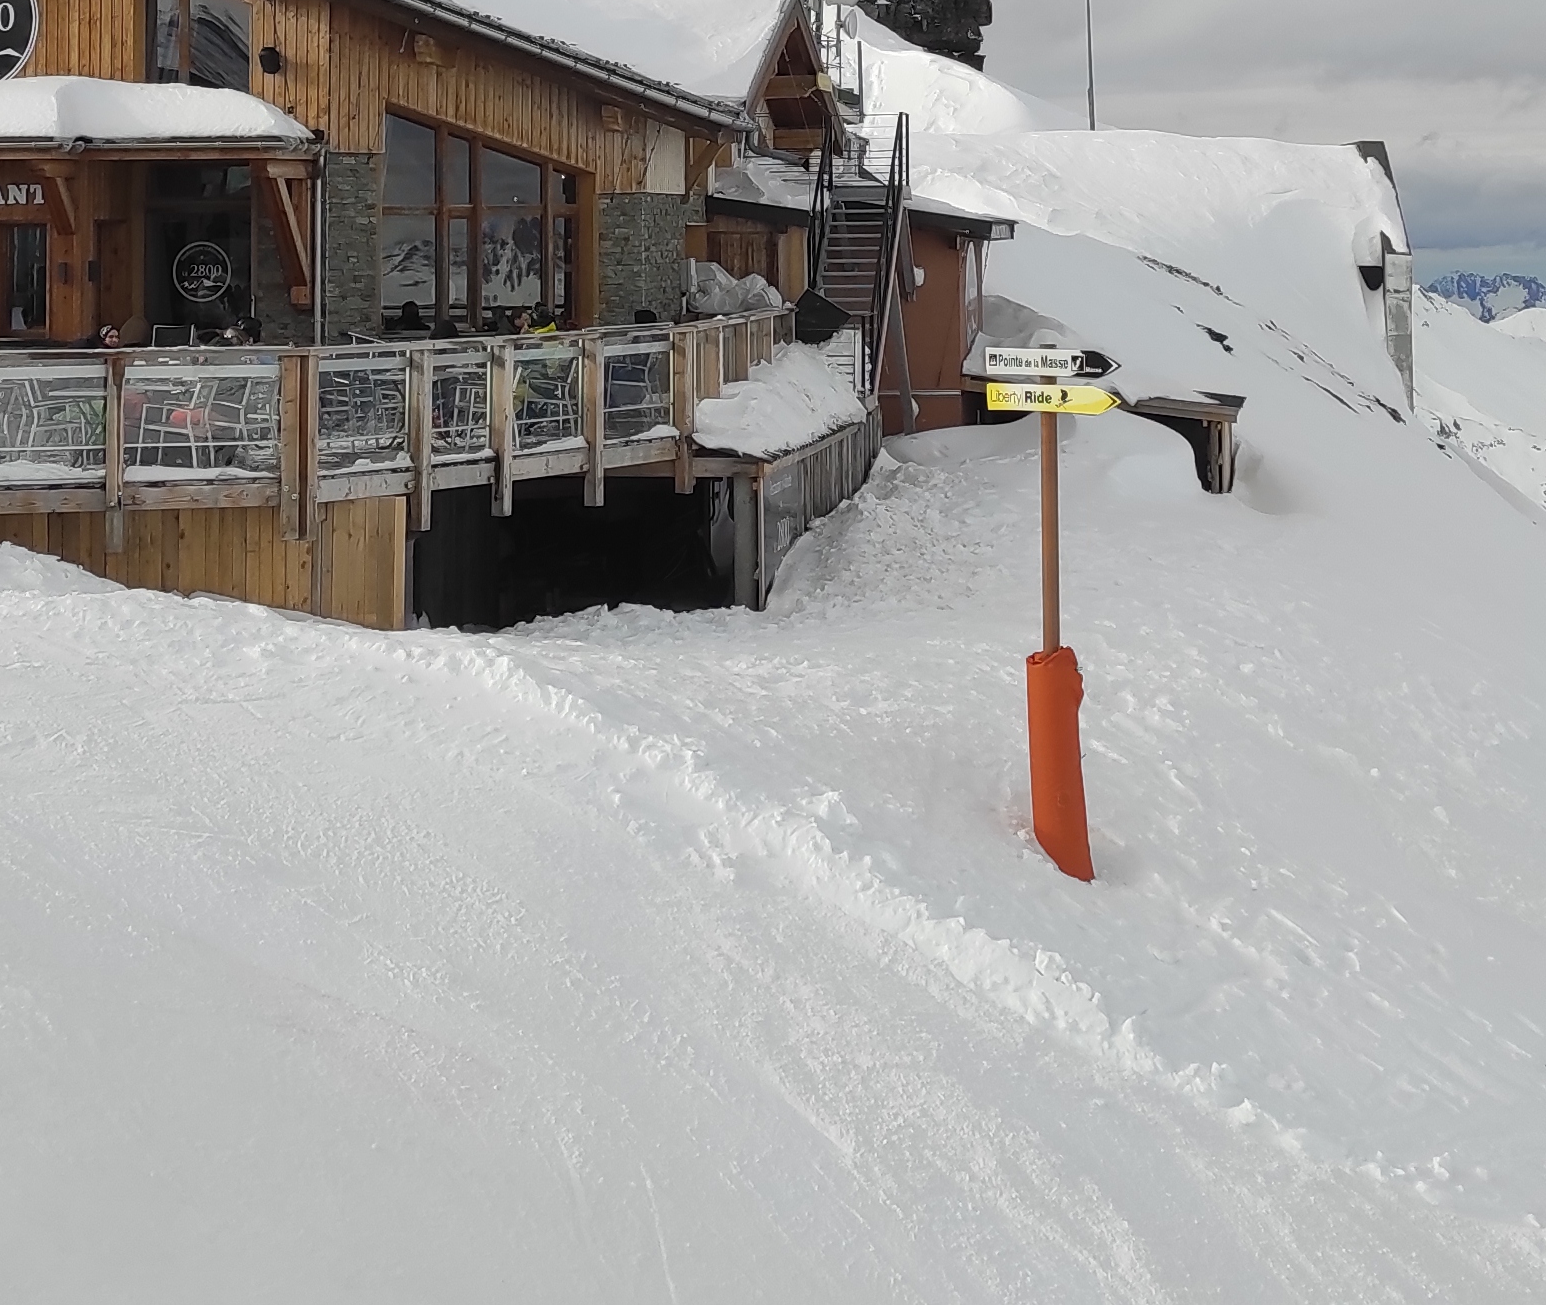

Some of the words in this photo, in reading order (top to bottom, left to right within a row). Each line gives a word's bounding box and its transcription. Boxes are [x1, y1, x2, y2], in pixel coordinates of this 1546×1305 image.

[189, 264, 222, 277] 2800
[998, 353, 1023, 368] Pointe
[1024, 357, 1032, 368] de
[1033, 358, 1040, 368] la
[1041, 355, 1069, 369] Masse
[990, 389, 1022, 406] Liberty
[1024, 390, 1053, 404] Ride
